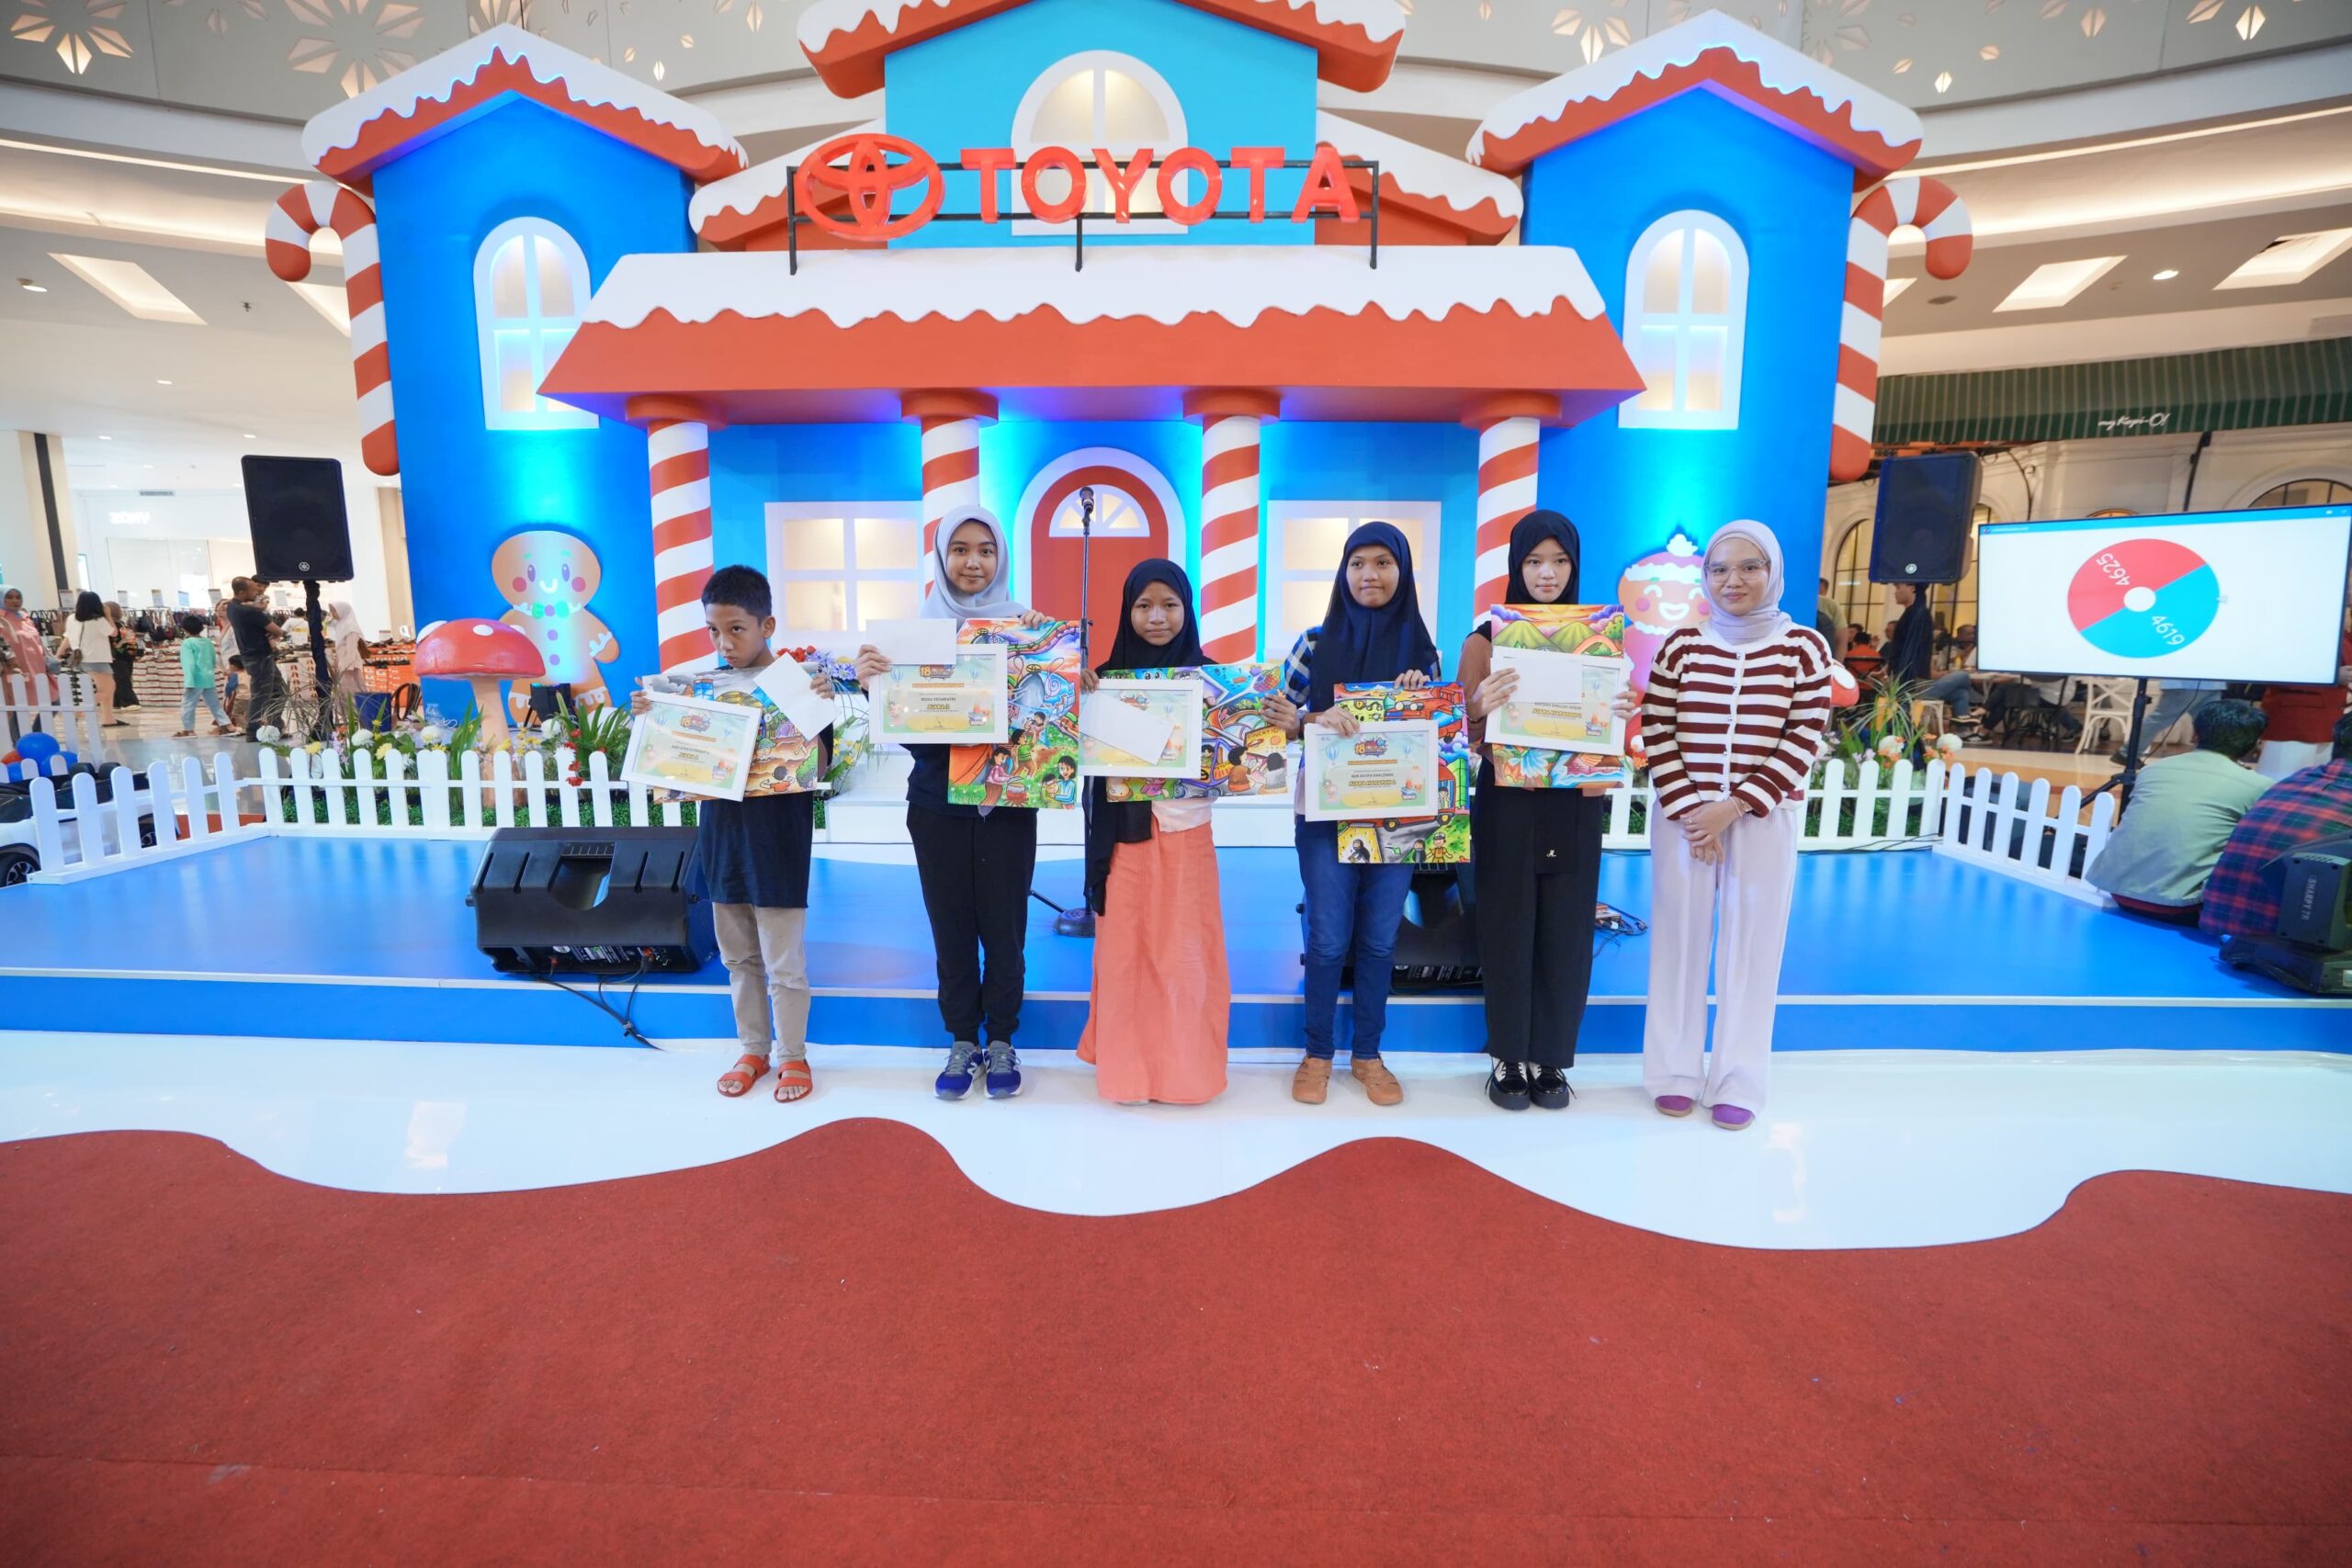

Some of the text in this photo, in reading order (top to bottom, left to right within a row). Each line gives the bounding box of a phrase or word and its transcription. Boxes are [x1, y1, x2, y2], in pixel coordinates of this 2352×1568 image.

[960, 141, 1361, 225] TOYOTA
[2096, 553, 2131, 586] 4625
[2151, 615, 2186, 646] 4619
[1248, 726, 1279, 739] EDUCATIO
